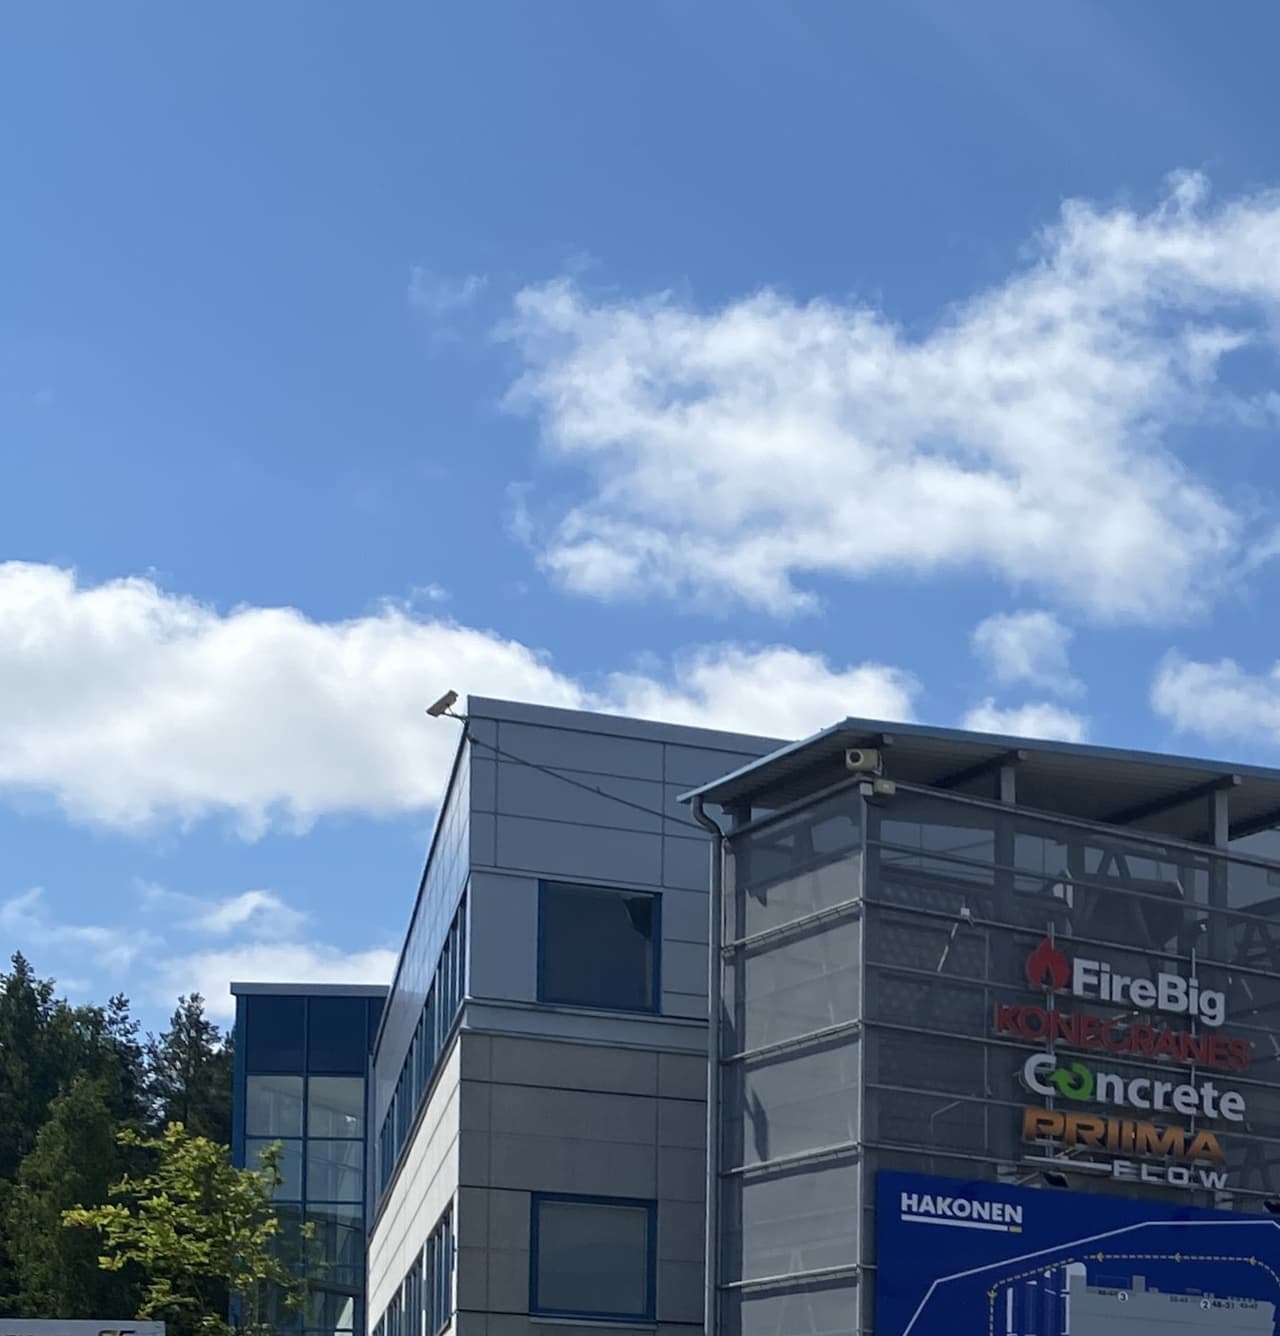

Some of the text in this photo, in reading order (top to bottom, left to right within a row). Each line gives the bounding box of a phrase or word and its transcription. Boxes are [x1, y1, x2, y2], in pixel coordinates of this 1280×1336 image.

[1073, 957, 1226, 1027] FireBig
[994, 1003, 1250, 1070] KONECRANES
[1024, 1053, 1246, 1122] Concrete
[1023, 1108, 1225, 1164] PRIIMA
[1112, 1160, 1229, 1189] FLOW
[901, 1192, 1023, 1223] HAKONEN
